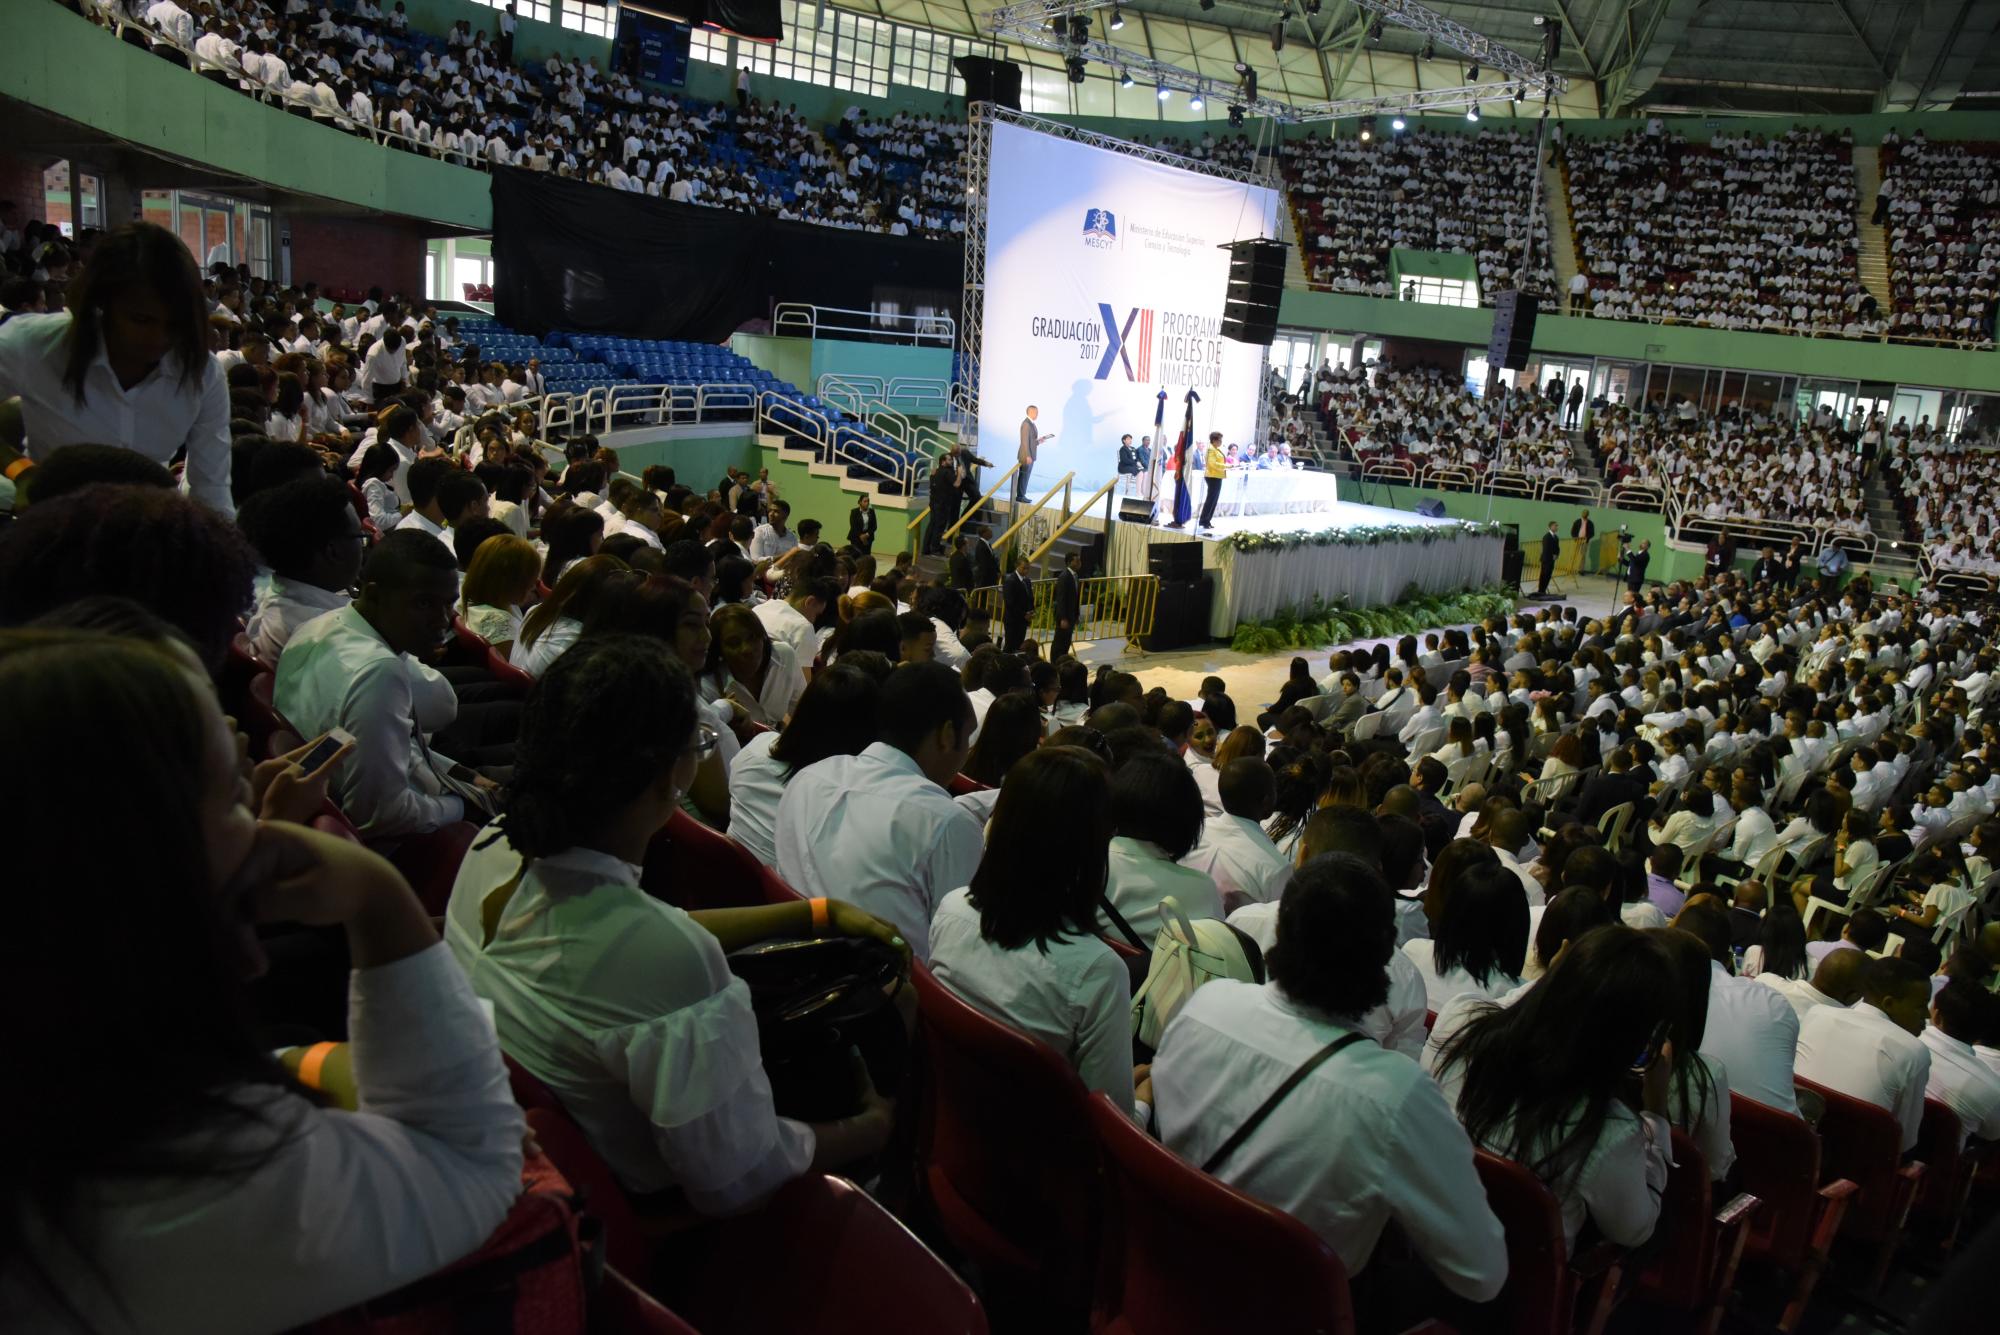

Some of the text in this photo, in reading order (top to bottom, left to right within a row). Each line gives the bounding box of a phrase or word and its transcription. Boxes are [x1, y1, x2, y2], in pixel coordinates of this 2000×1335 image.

[1084, 237, 1113, 250] MESCYT
[1032, 316, 1100, 343] GRADUACIÓN
[1080, 343, 1100, 360] 2017
[1160, 336, 1223, 365] INGLÉS DE
[1159, 362, 1222, 389] INMERSIÓN
